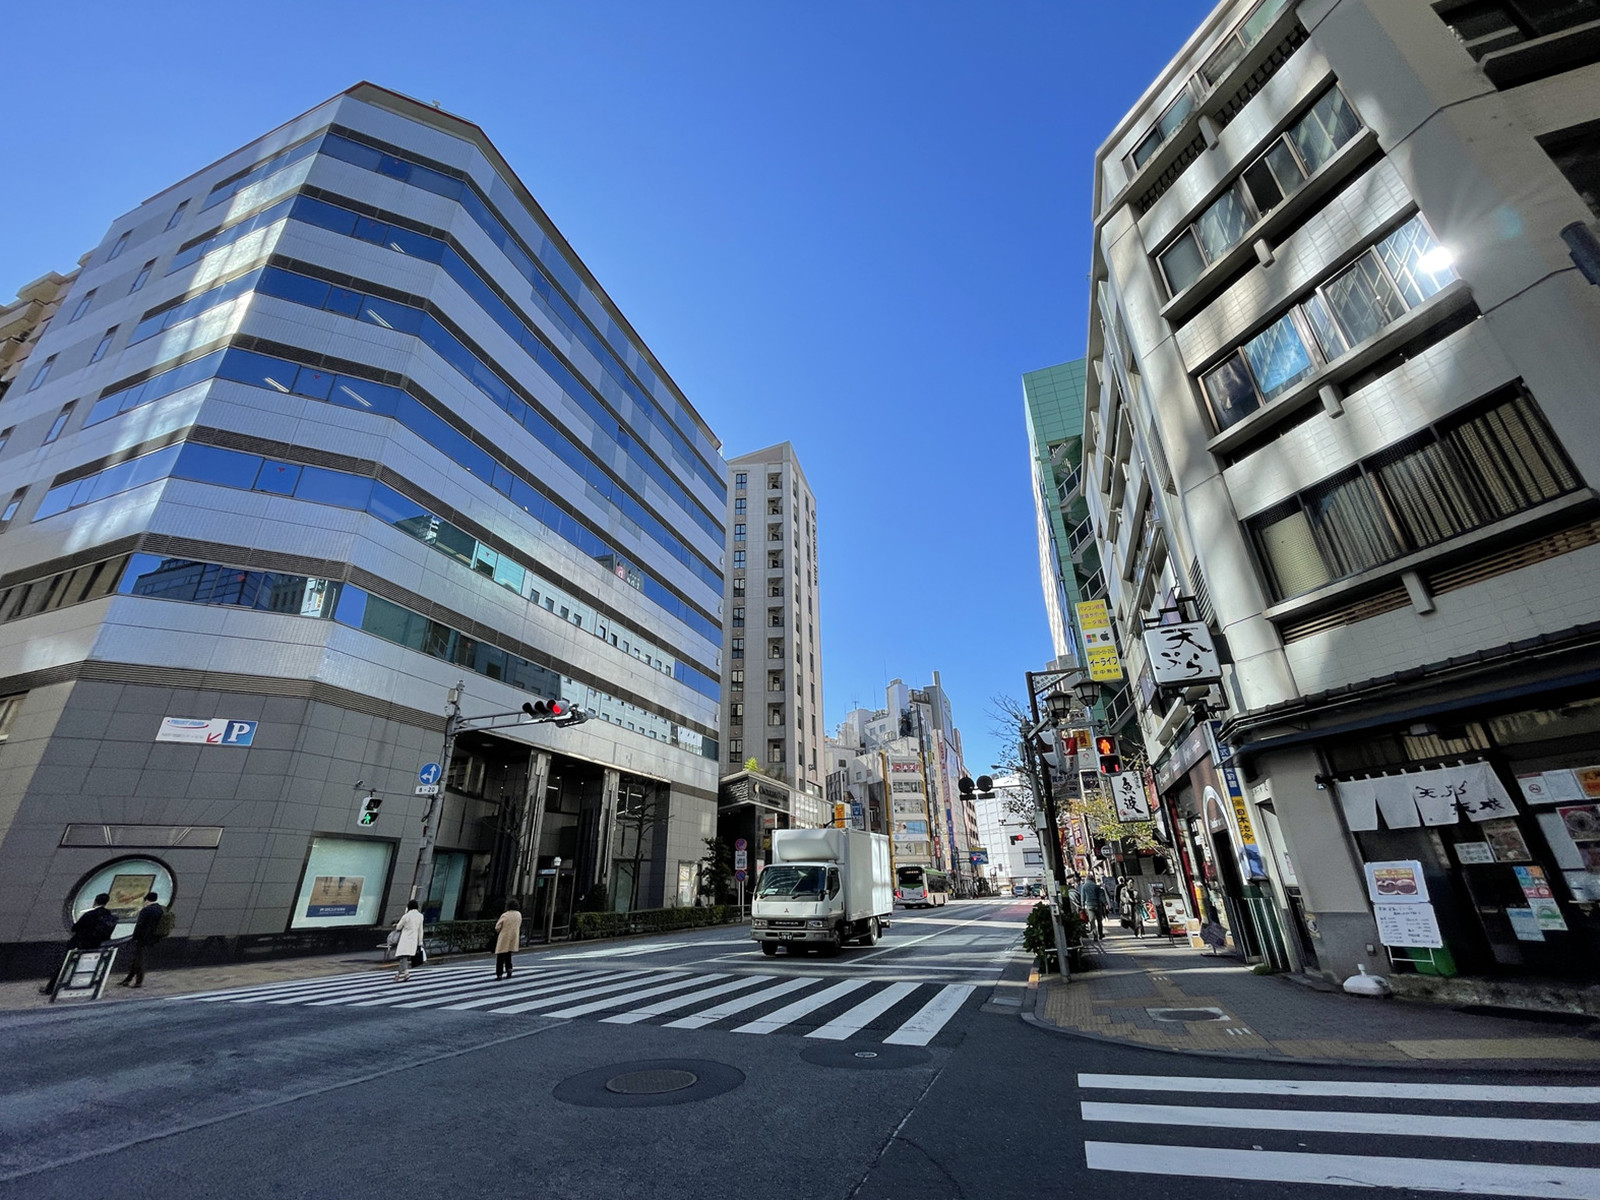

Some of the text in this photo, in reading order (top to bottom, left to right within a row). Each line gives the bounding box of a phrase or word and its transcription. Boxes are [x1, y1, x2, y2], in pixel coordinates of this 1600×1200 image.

[1090, 656, 1118, 667] イーライフ
[227, 722, 251, 742] P
